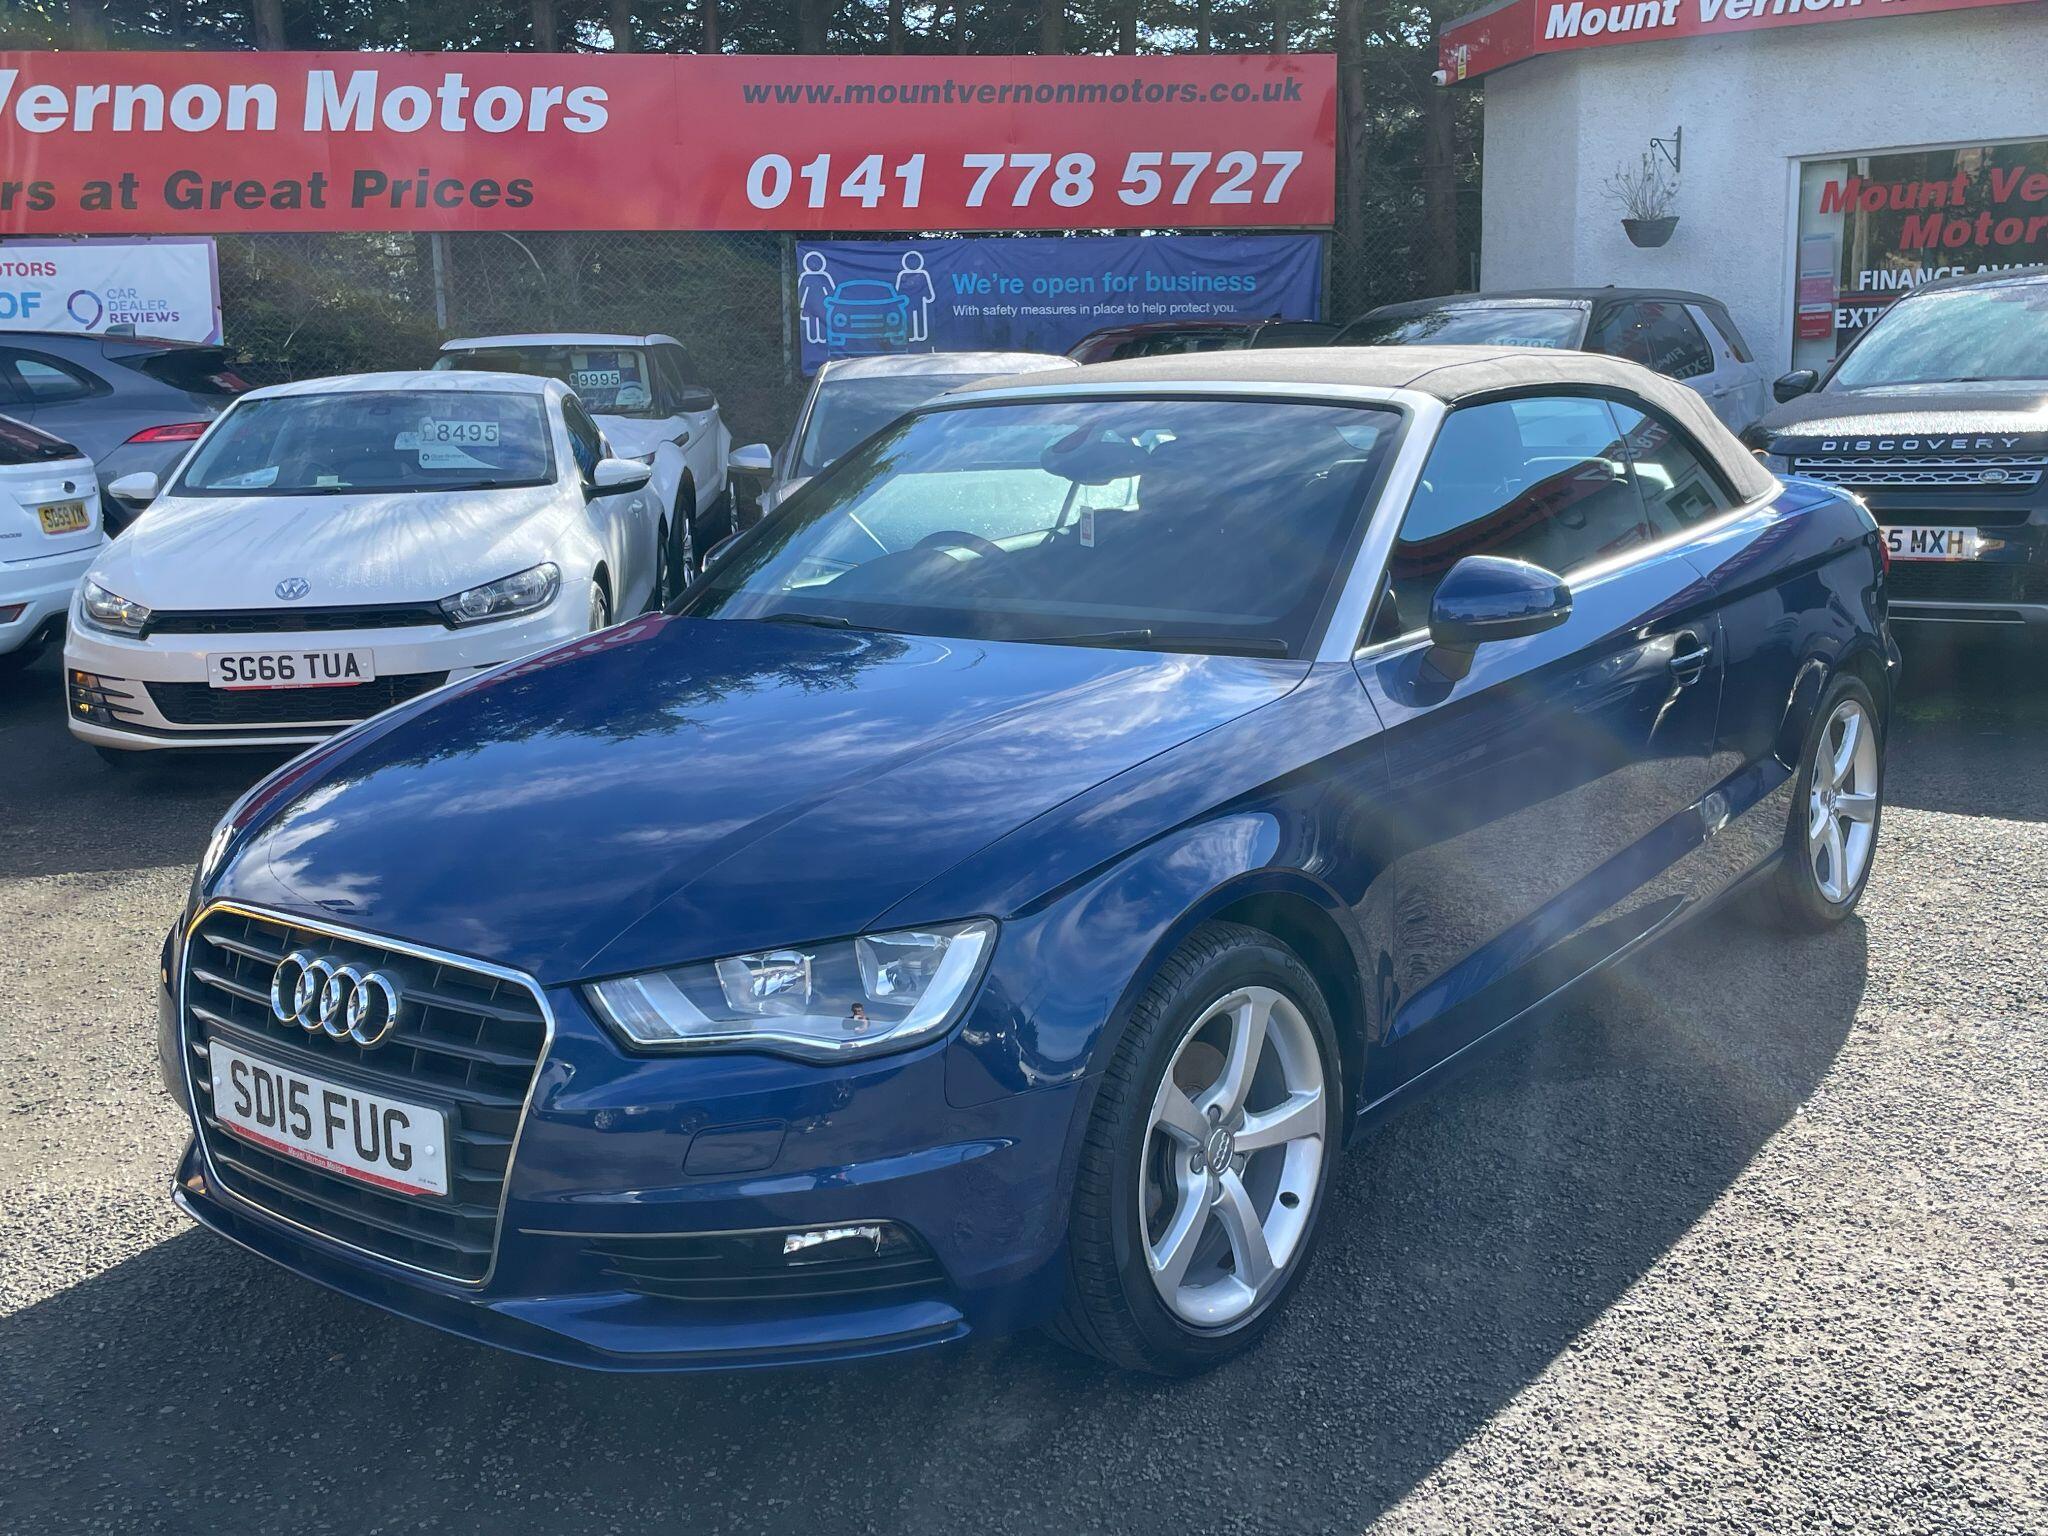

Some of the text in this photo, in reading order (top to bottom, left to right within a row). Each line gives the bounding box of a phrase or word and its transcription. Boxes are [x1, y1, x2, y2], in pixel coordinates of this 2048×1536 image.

[1545, 0, 1677, 39] Mount
[303, 70, 609, 133] Motors
[743, 77, 1303, 105] www.mountvernonmotors.co.uk
[80, 173, 139, 211] at
[163, 169, 329, 211] Great
[351, 169, 535, 209] Prices
[746, 151, 1304, 209] 0141 778 5727
[1819, 171, 1970, 214] Mount
[1900, 212, 2048, 250] Motor
[0, 262, 57, 277] TORS
[106, 289, 137, 300] CAR
[1032, 274, 1095, 298] open
[1102, 272, 1138, 293] for
[1146, 271, 1257, 292] business
[108, 299, 168, 312] DEALER
[109, 311, 180, 324] REVIEWS
[953, 302, 1237, 318] With safety measures in place to help protect you.
[421, 422, 498, 442] £8495
[1821, 437, 2020, 451] DISCOVERY
[1880, 529, 1963, 553] 5 MXH
[219, 652, 361, 682] SG66 TUA
[231, 1059, 412, 1172] SD15 FUG
